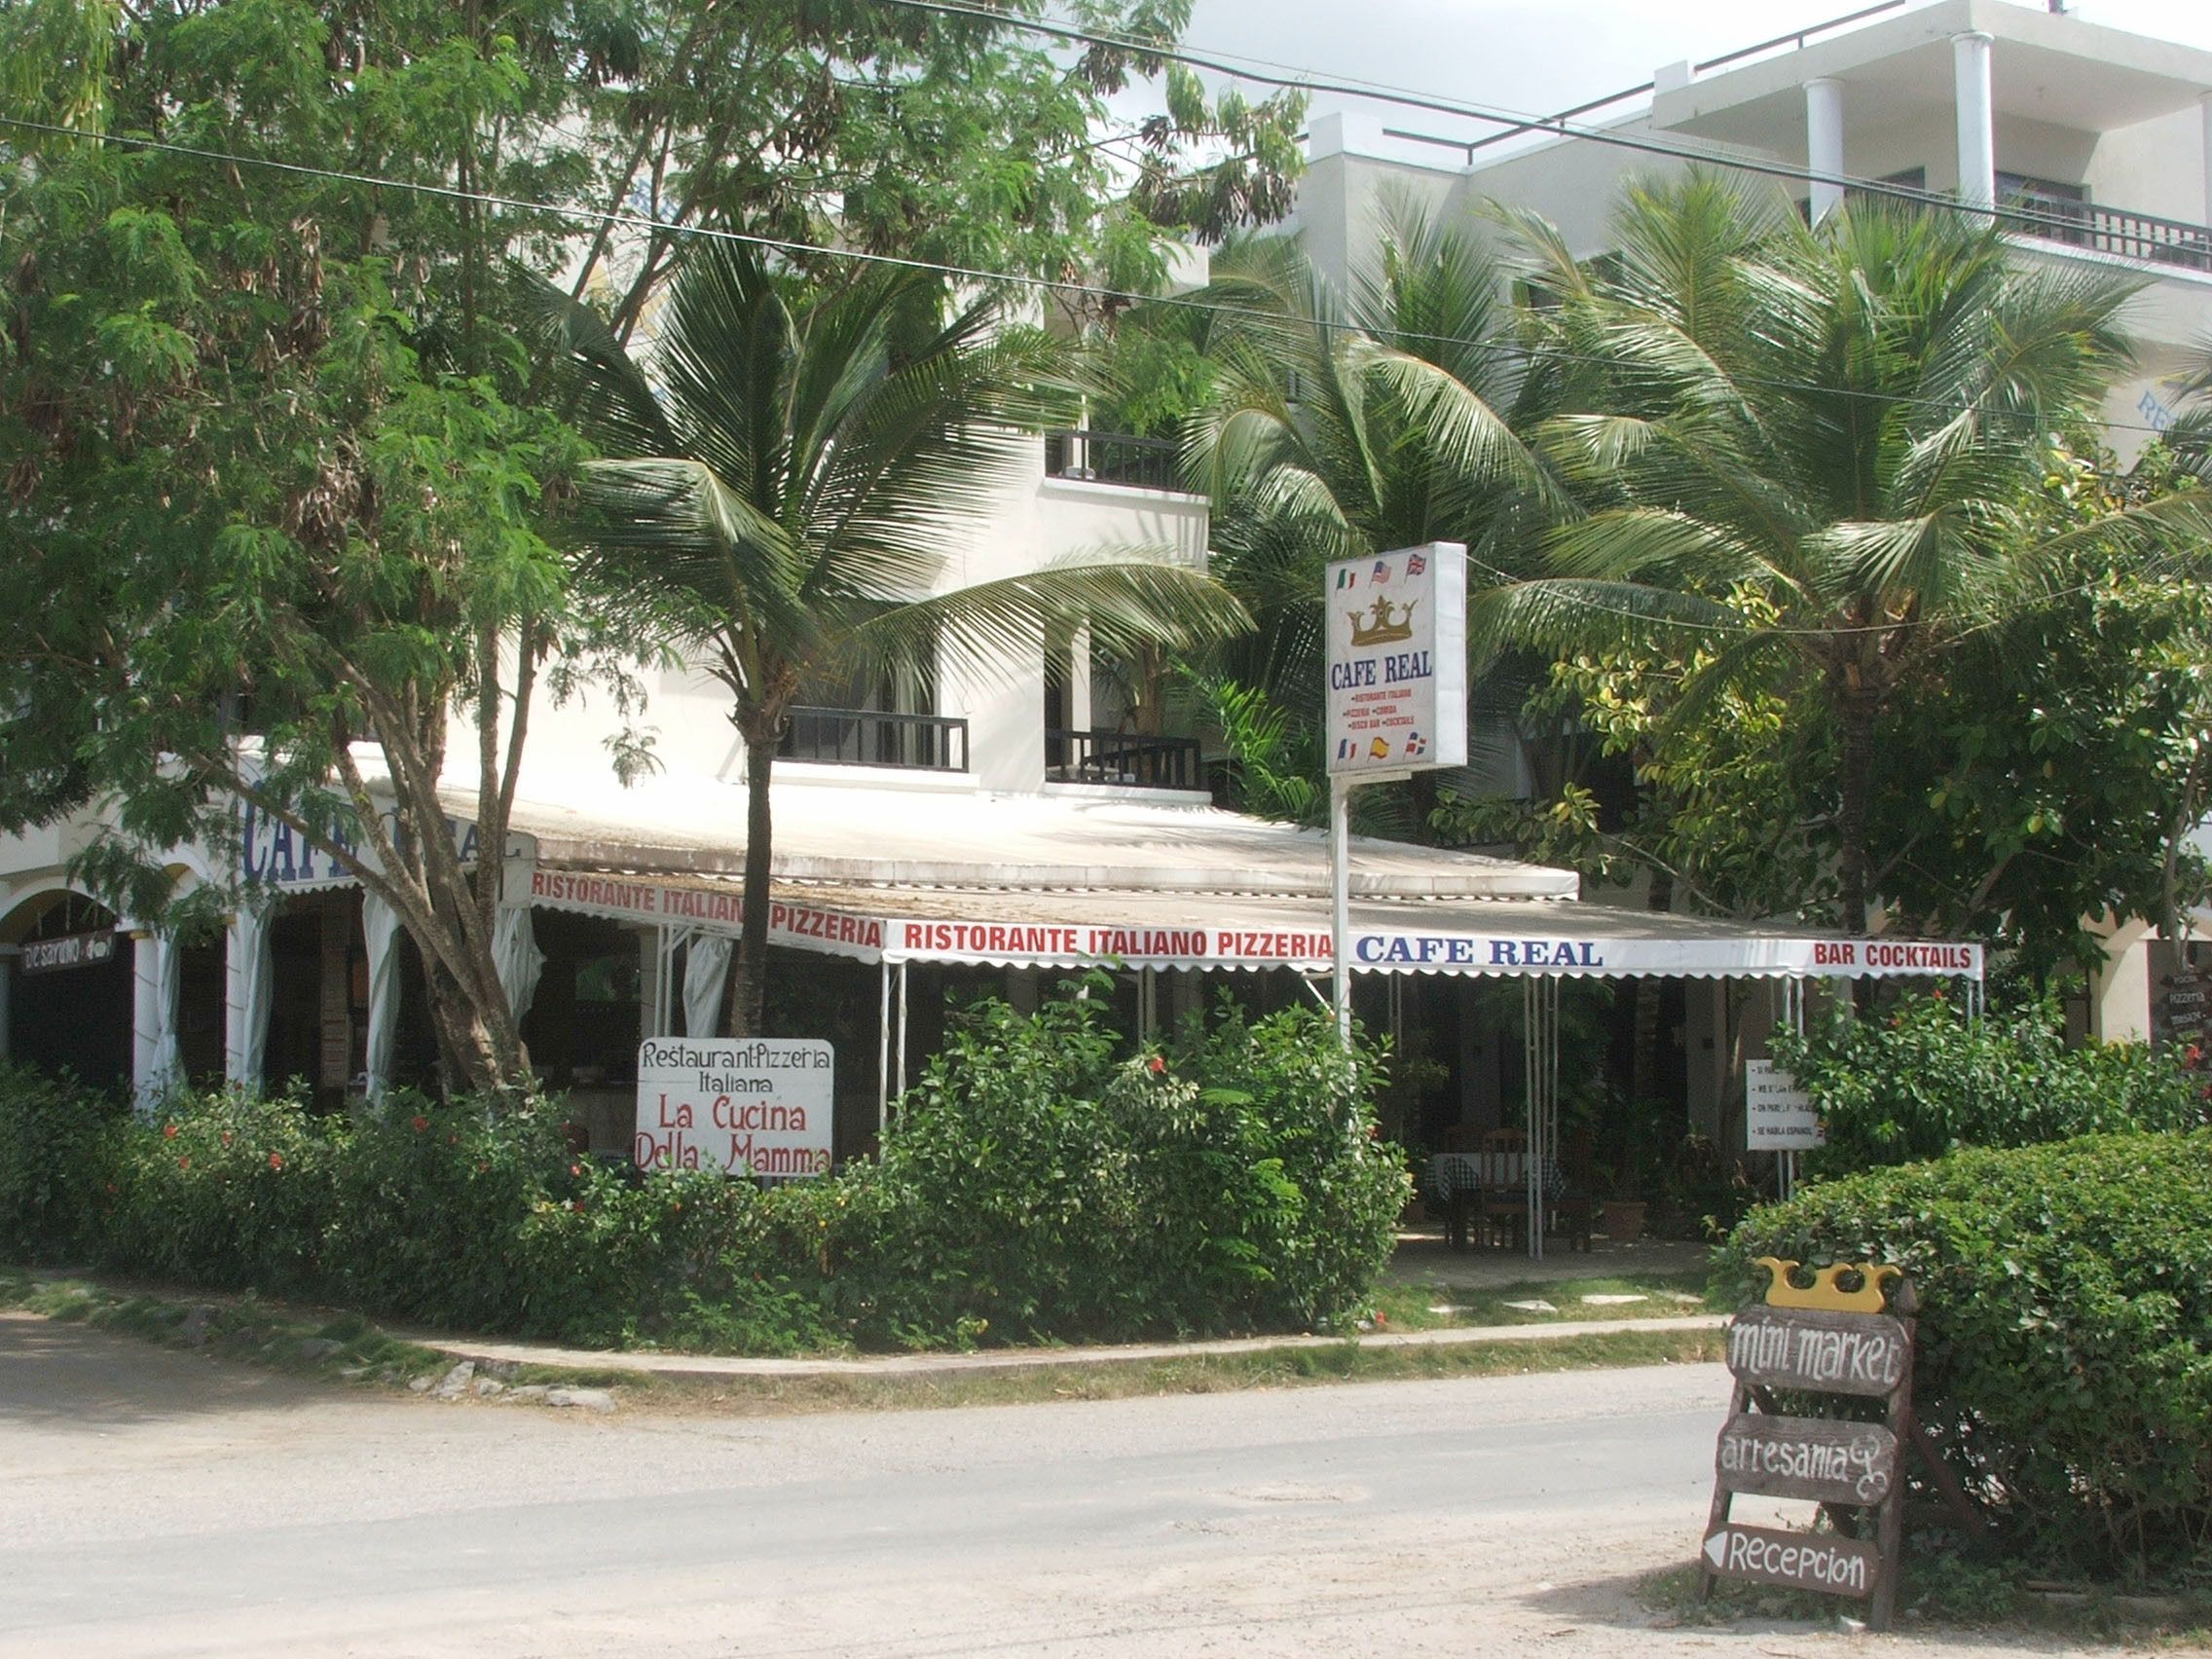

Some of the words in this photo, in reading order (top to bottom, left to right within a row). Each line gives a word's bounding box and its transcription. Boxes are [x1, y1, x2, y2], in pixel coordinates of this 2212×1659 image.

[1331, 659, 1376, 690] CAFE
[1384, 650, 1432, 683] REAL
[532, 872, 655, 912] RISTORANTE
[663, 889, 745, 924] ITALIAN
[771, 904, 881, 948] PIZZERIA
[904, 923, 1077, 954] RISTORANTE
[1088, 929, 1207, 956] ITALIANO
[1218, 932, 1333, 958] PIZZERIA
[1356, 936, 1474, 963] CAFE
[1488, 938, 1604, 966] REAL
[1814, 942, 1855, 965] BAR
[1865, 944, 1972, 970] COCKTAILS
[699, 1071, 773, 1093] Italiana
[659, 1093, 693, 1128] La
[713, 1094, 806, 1130] Cucina
[636, 1131, 698, 1169] Della
[722, 1133, 830, 1173] Mamma
[1731, 1315, 1790, 1375] mini
[1796, 1327, 1900, 1385] market
